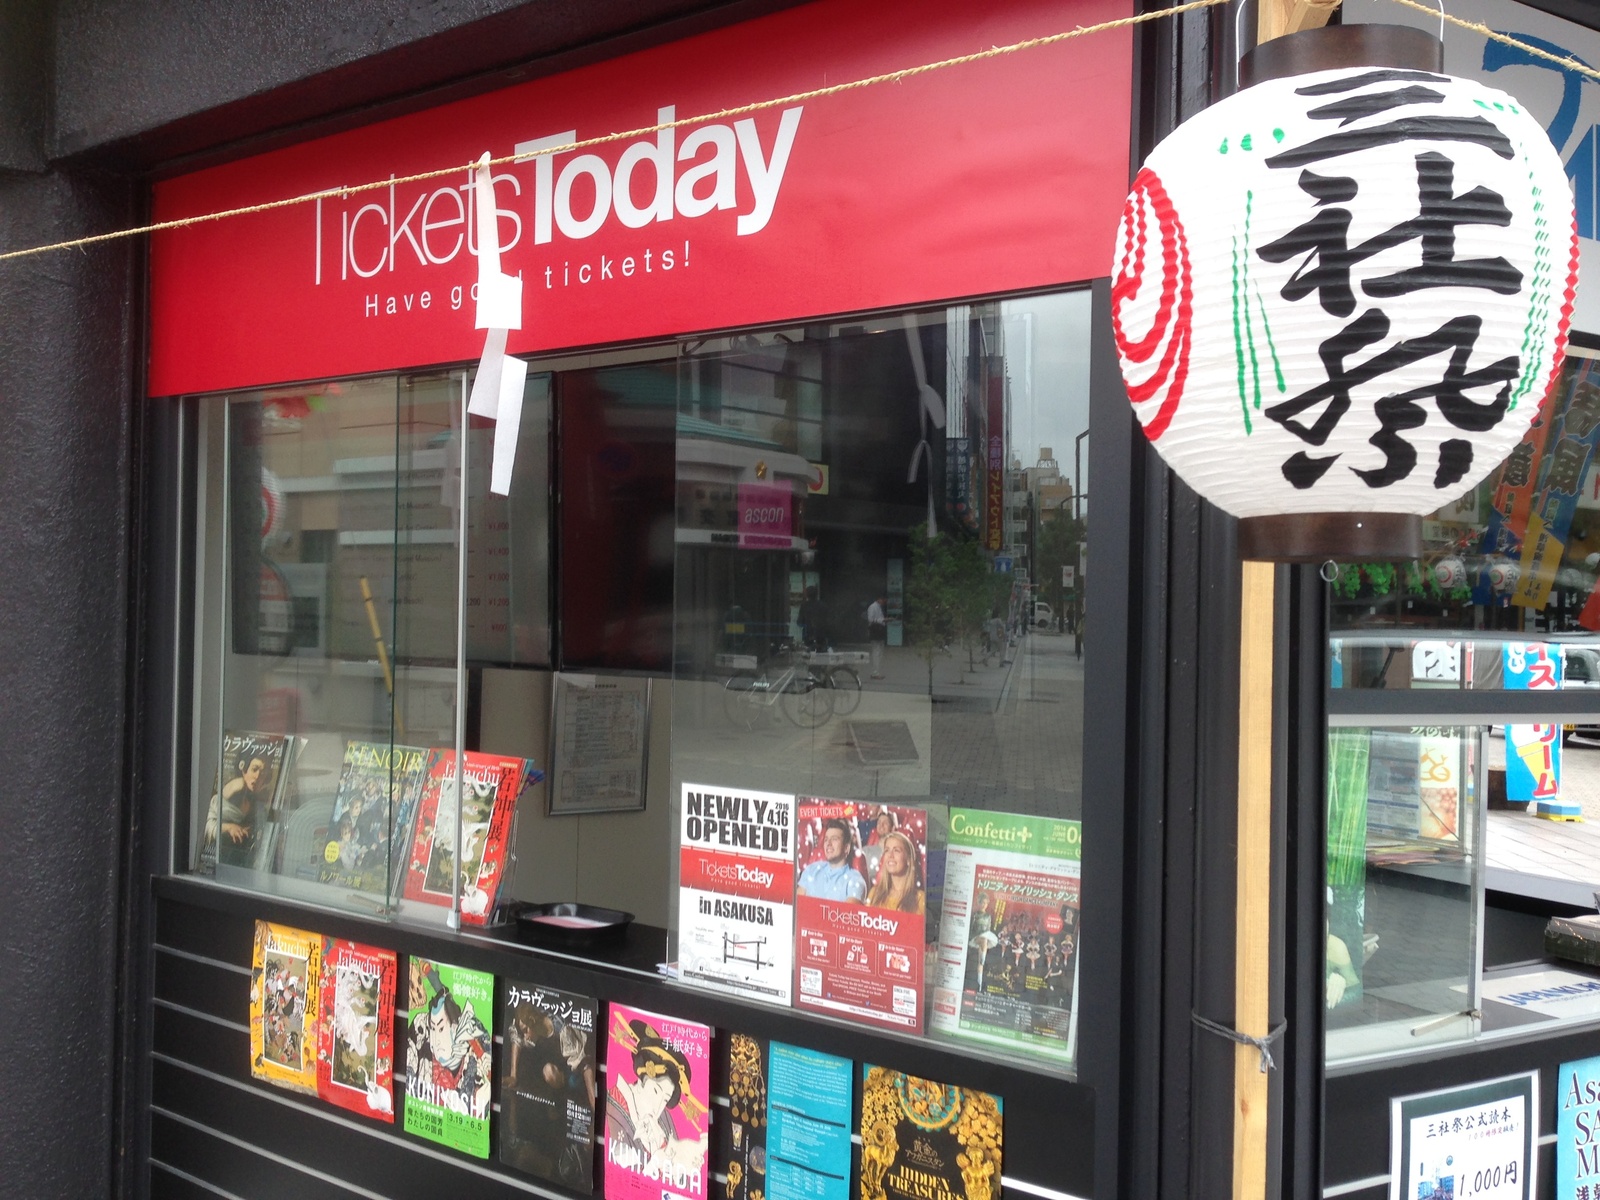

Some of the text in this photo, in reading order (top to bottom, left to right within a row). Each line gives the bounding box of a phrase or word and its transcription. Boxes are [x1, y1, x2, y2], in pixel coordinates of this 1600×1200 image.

[365, 290, 431, 317] Have
[545, 240, 691, 289] tickets!
[1256, 68, 1523, 490] 三社祭
[744, 507, 785, 523] ascon
[687, 792, 768, 824] NEWLY
[800, 806, 843, 818] EVENT TICKETS
[686, 810, 789, 853] OPENED! 4.16
[699, 896, 774, 926] in ASAKUSA
[507, 985, 593, 1028] カラヴァッジョ展
[661, 1022, 708, 1041] 江戸時代から
[407, 1076, 485, 1122] KUNIYOSHI
[1426, 1106, 1512, 1139] 三社祭公式読本
[608, 1136, 702, 1195] KUNISADA
[904, 1148, 945, 1168] アフガニスタン
[900, 1165, 951, 1192] HIDDEN
[1459, 1160, 1518, 1198] 1,000円
